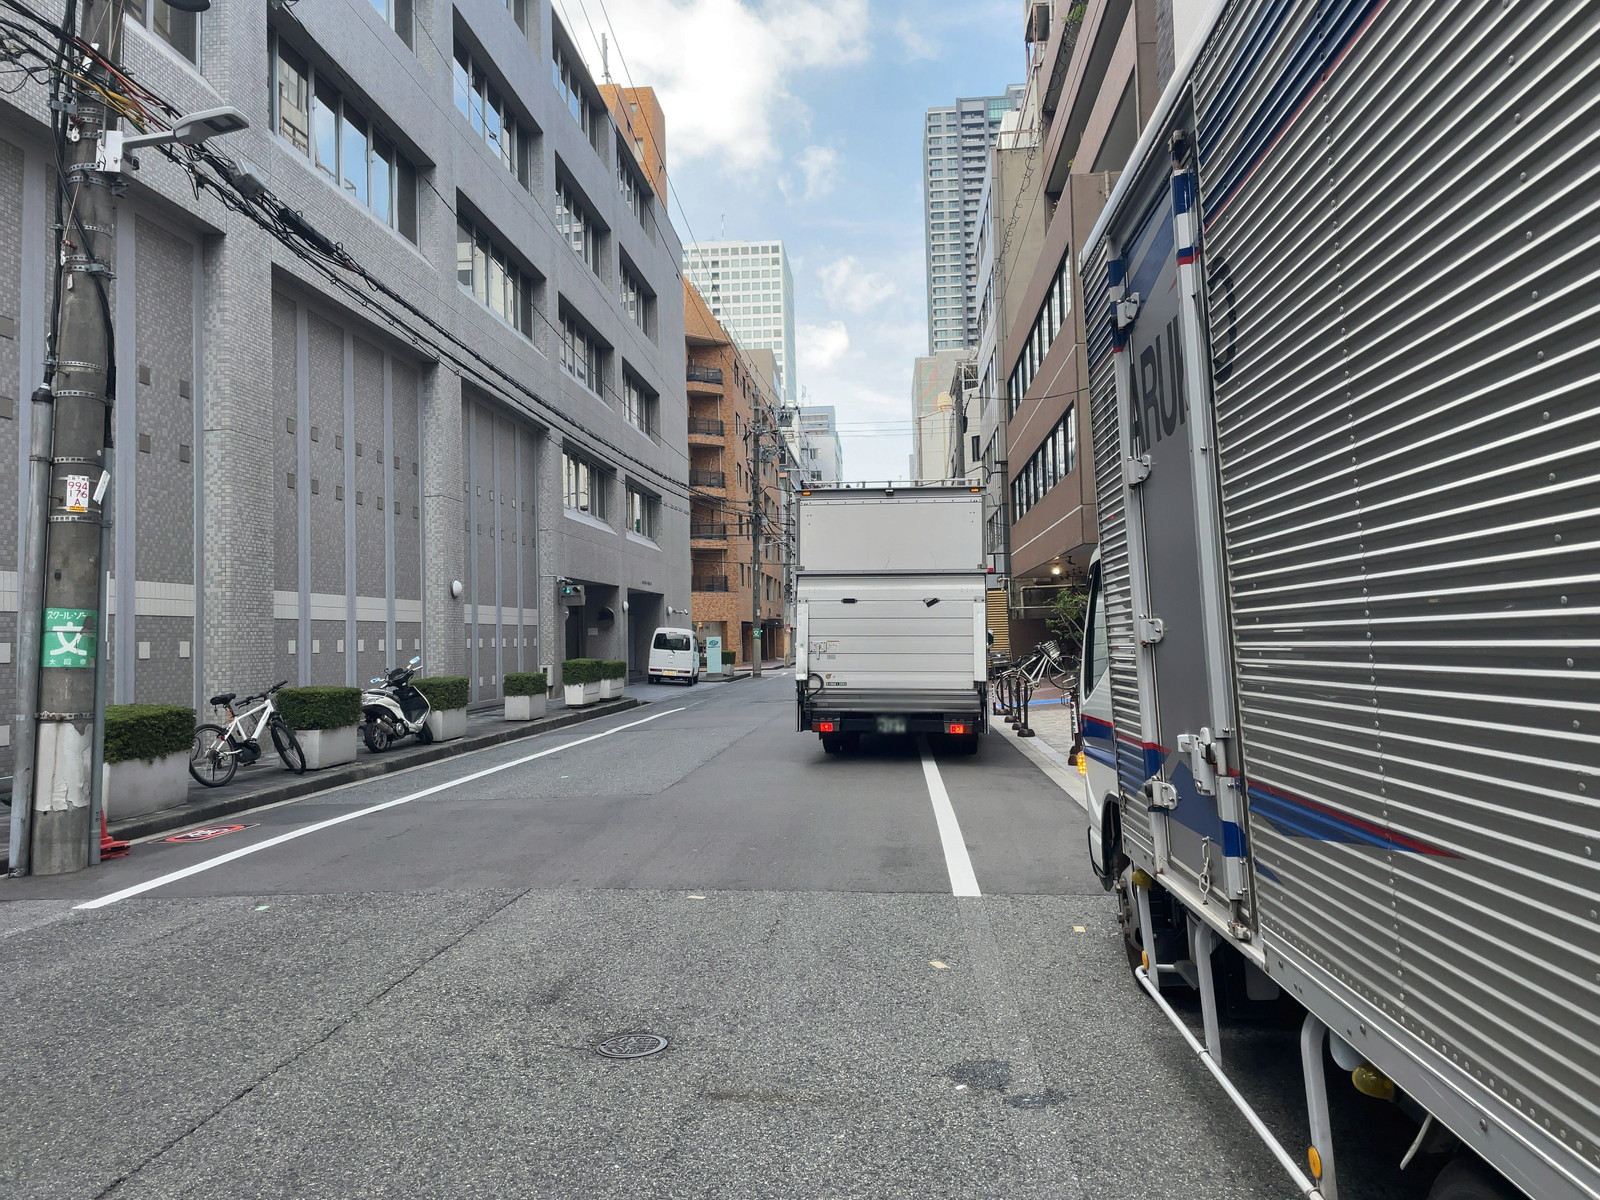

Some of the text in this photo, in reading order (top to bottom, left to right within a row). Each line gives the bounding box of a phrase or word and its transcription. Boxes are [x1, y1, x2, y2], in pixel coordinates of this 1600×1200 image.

[68, 481, 88, 490] 994
[69, 490, 88, 498] 176
[74, 498, 81, 506] A
